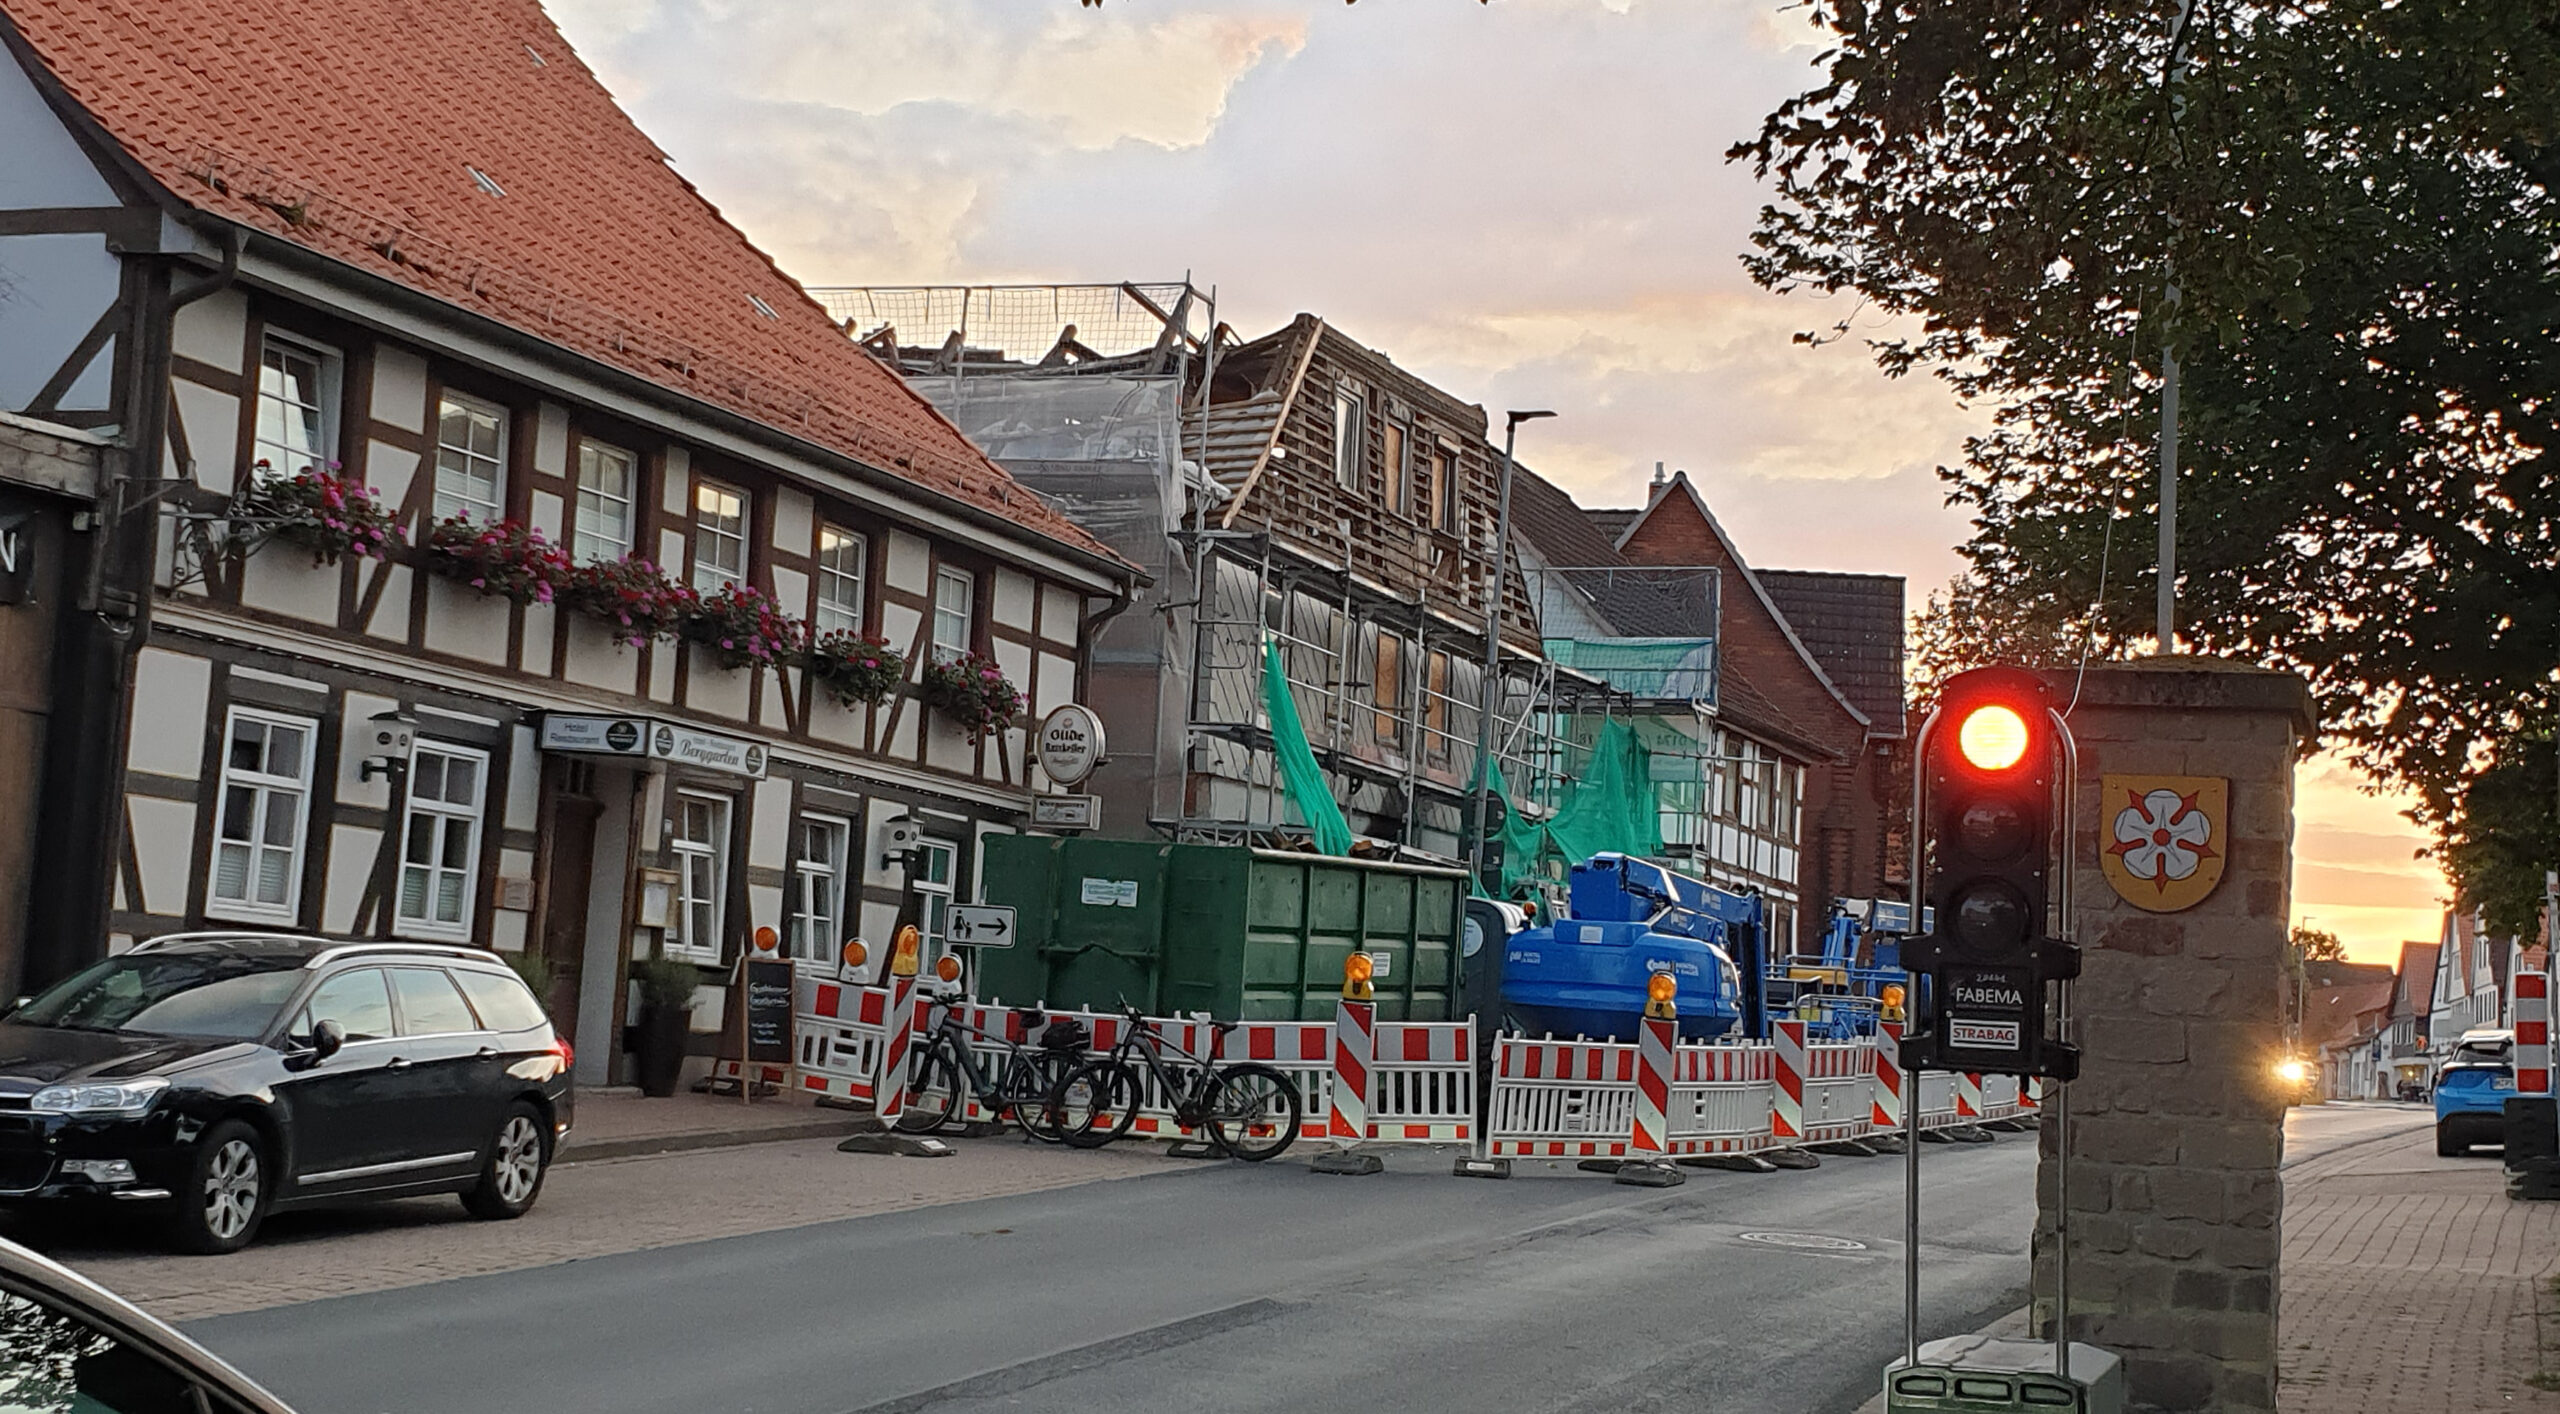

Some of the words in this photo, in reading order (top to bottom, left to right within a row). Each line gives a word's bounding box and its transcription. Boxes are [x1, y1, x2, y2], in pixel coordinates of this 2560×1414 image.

[680, 738, 740, 767] Berggarten
[1956, 987, 2023, 1005] FABEMA
[1953, 1027, 2015, 1041] STRABAG
